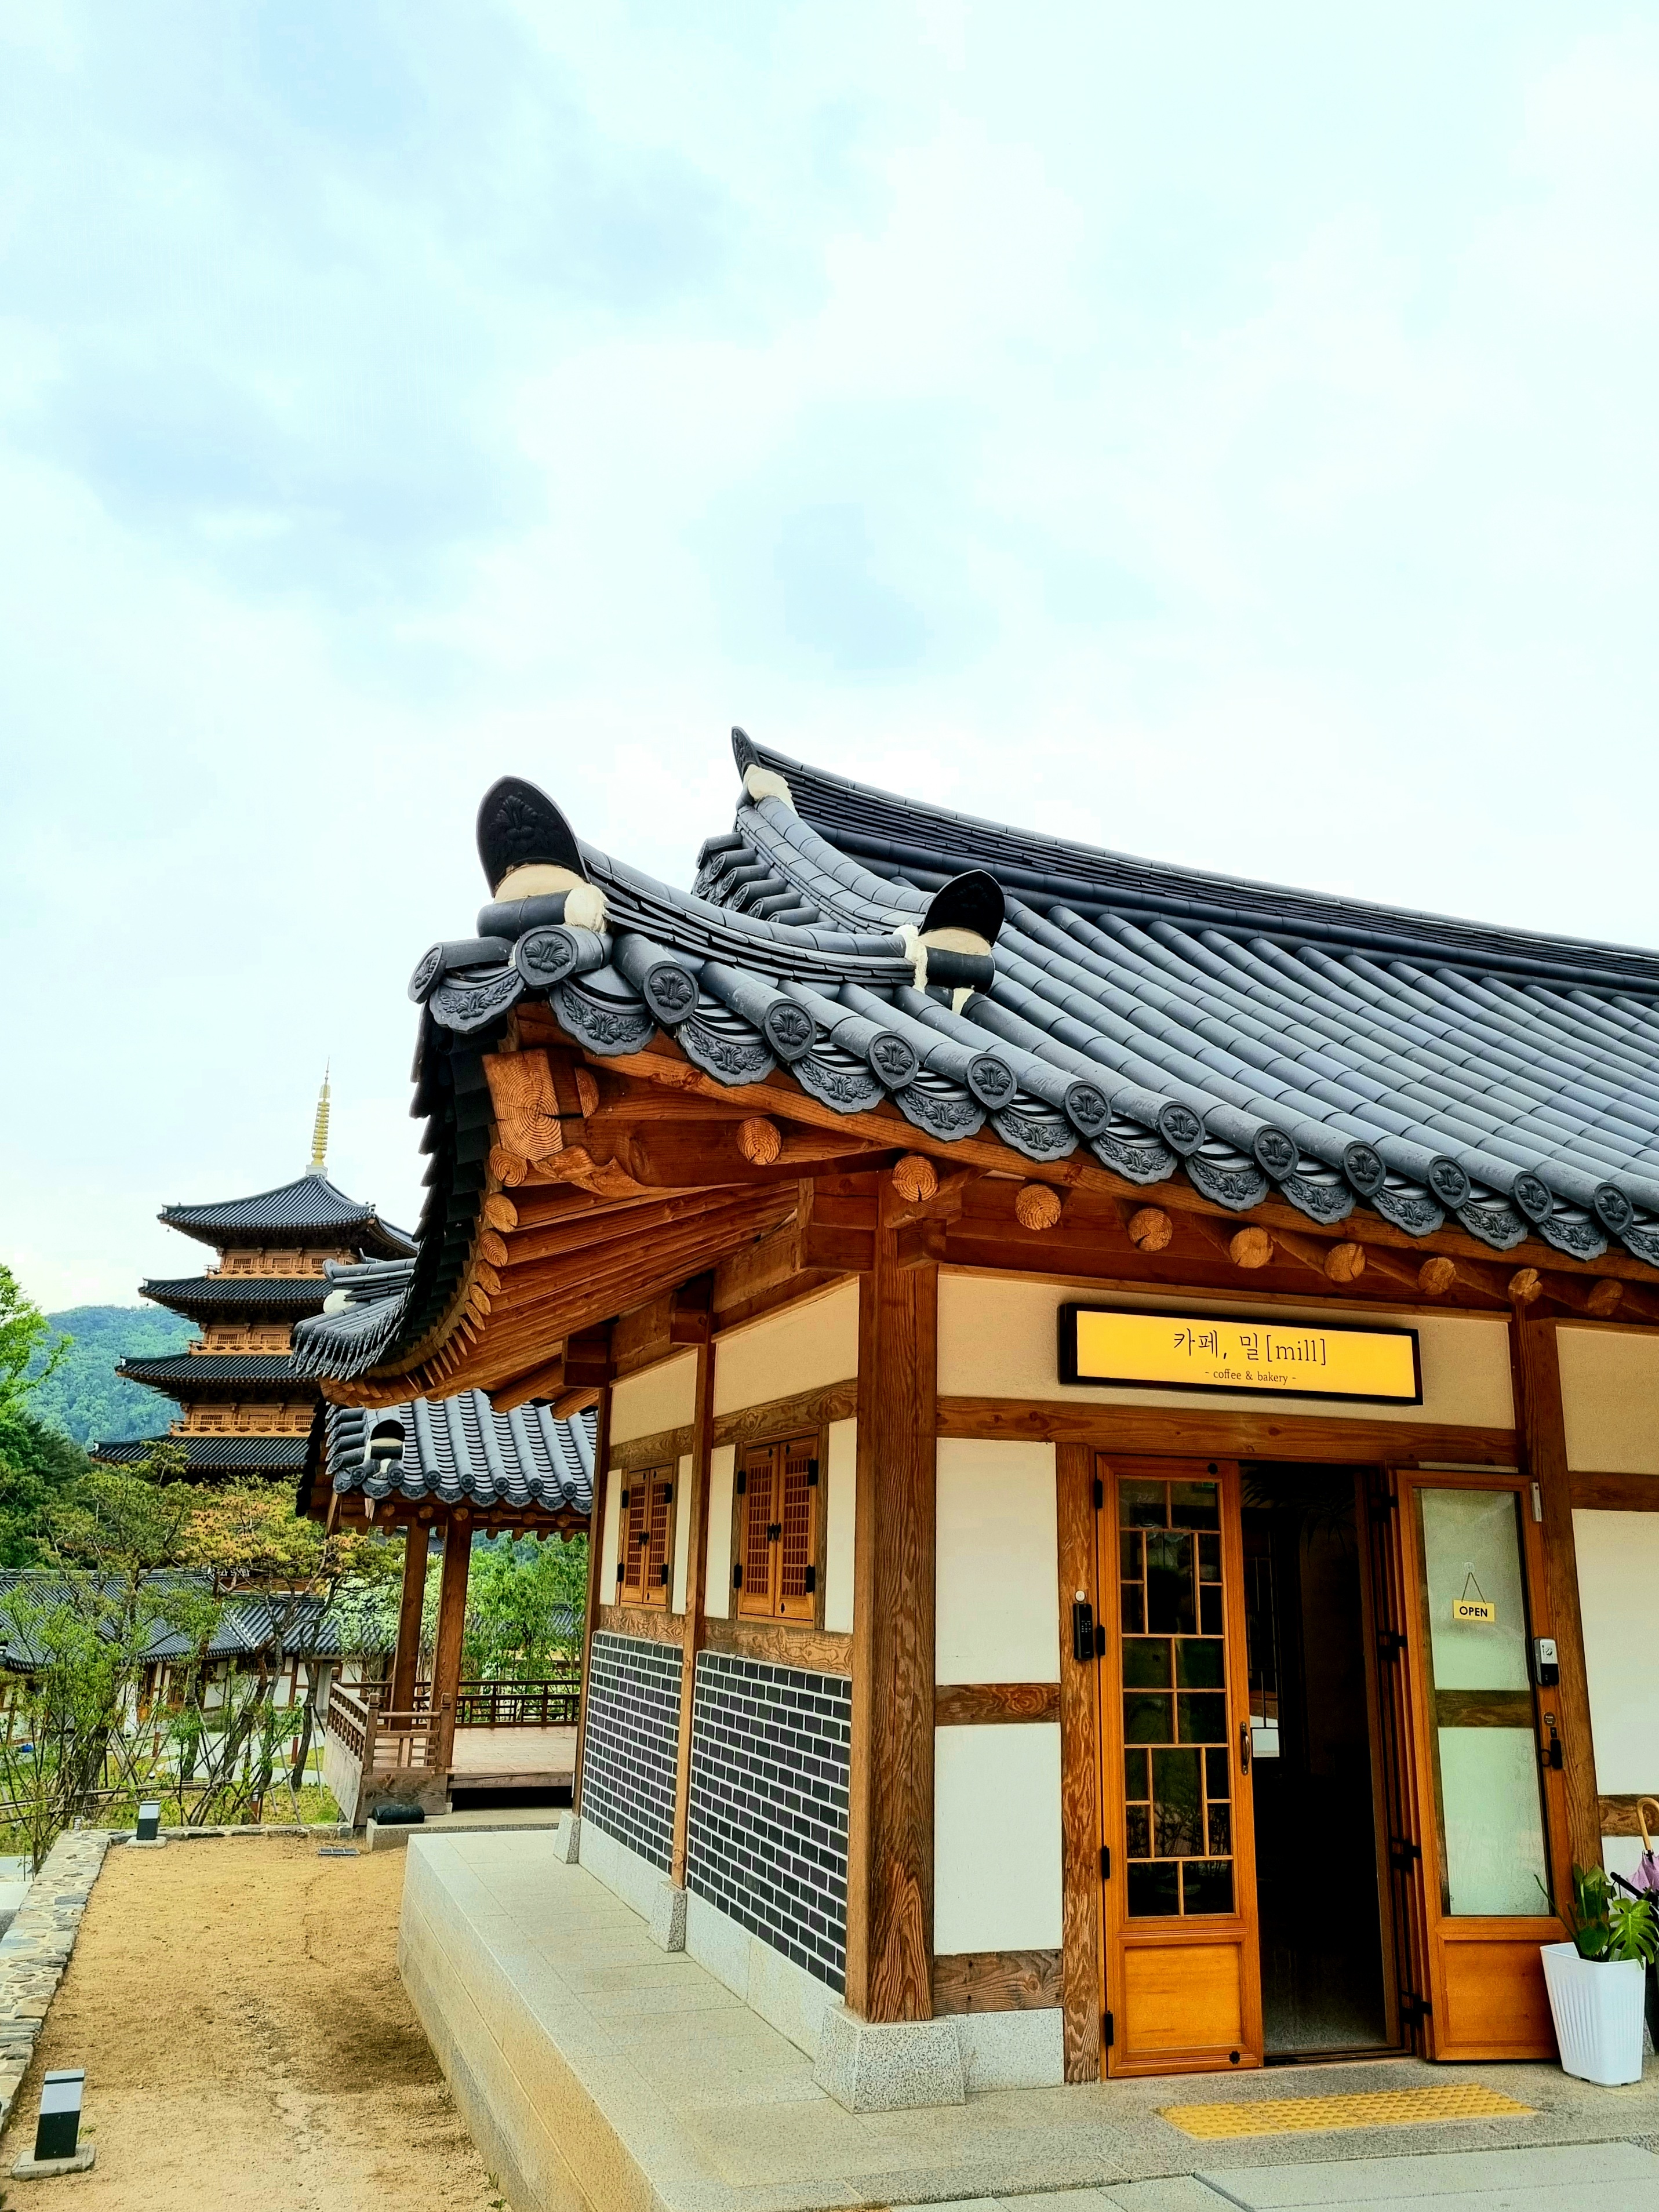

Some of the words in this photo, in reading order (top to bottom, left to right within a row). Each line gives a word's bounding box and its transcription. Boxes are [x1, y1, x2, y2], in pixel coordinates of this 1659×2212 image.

[1173, 1327, 1227, 1360] 카페,
[1213, 1368, 1242, 1381] coffee
[1245, 1370, 1254, 1381] &
[1257, 1370, 1289, 1386] bakery
[1459, 1606, 1488, 1618] OPEN
